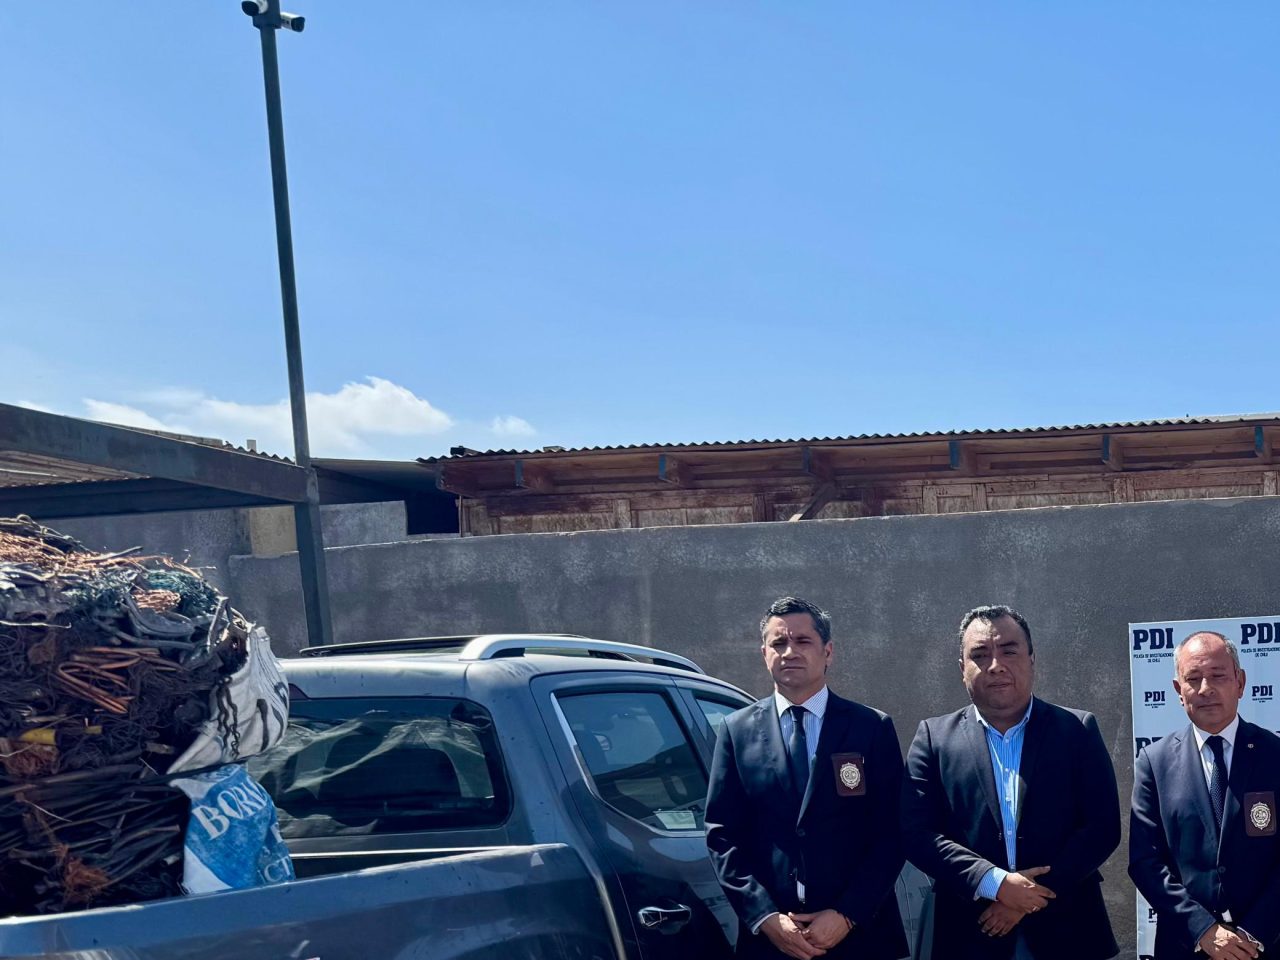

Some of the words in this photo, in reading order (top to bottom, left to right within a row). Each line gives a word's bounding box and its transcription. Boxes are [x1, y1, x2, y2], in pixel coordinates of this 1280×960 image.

[1133, 628, 1174, 650] PDI
[1144, 690, 1165, 702] PDI
[1252, 685, 1273, 697] PDI
